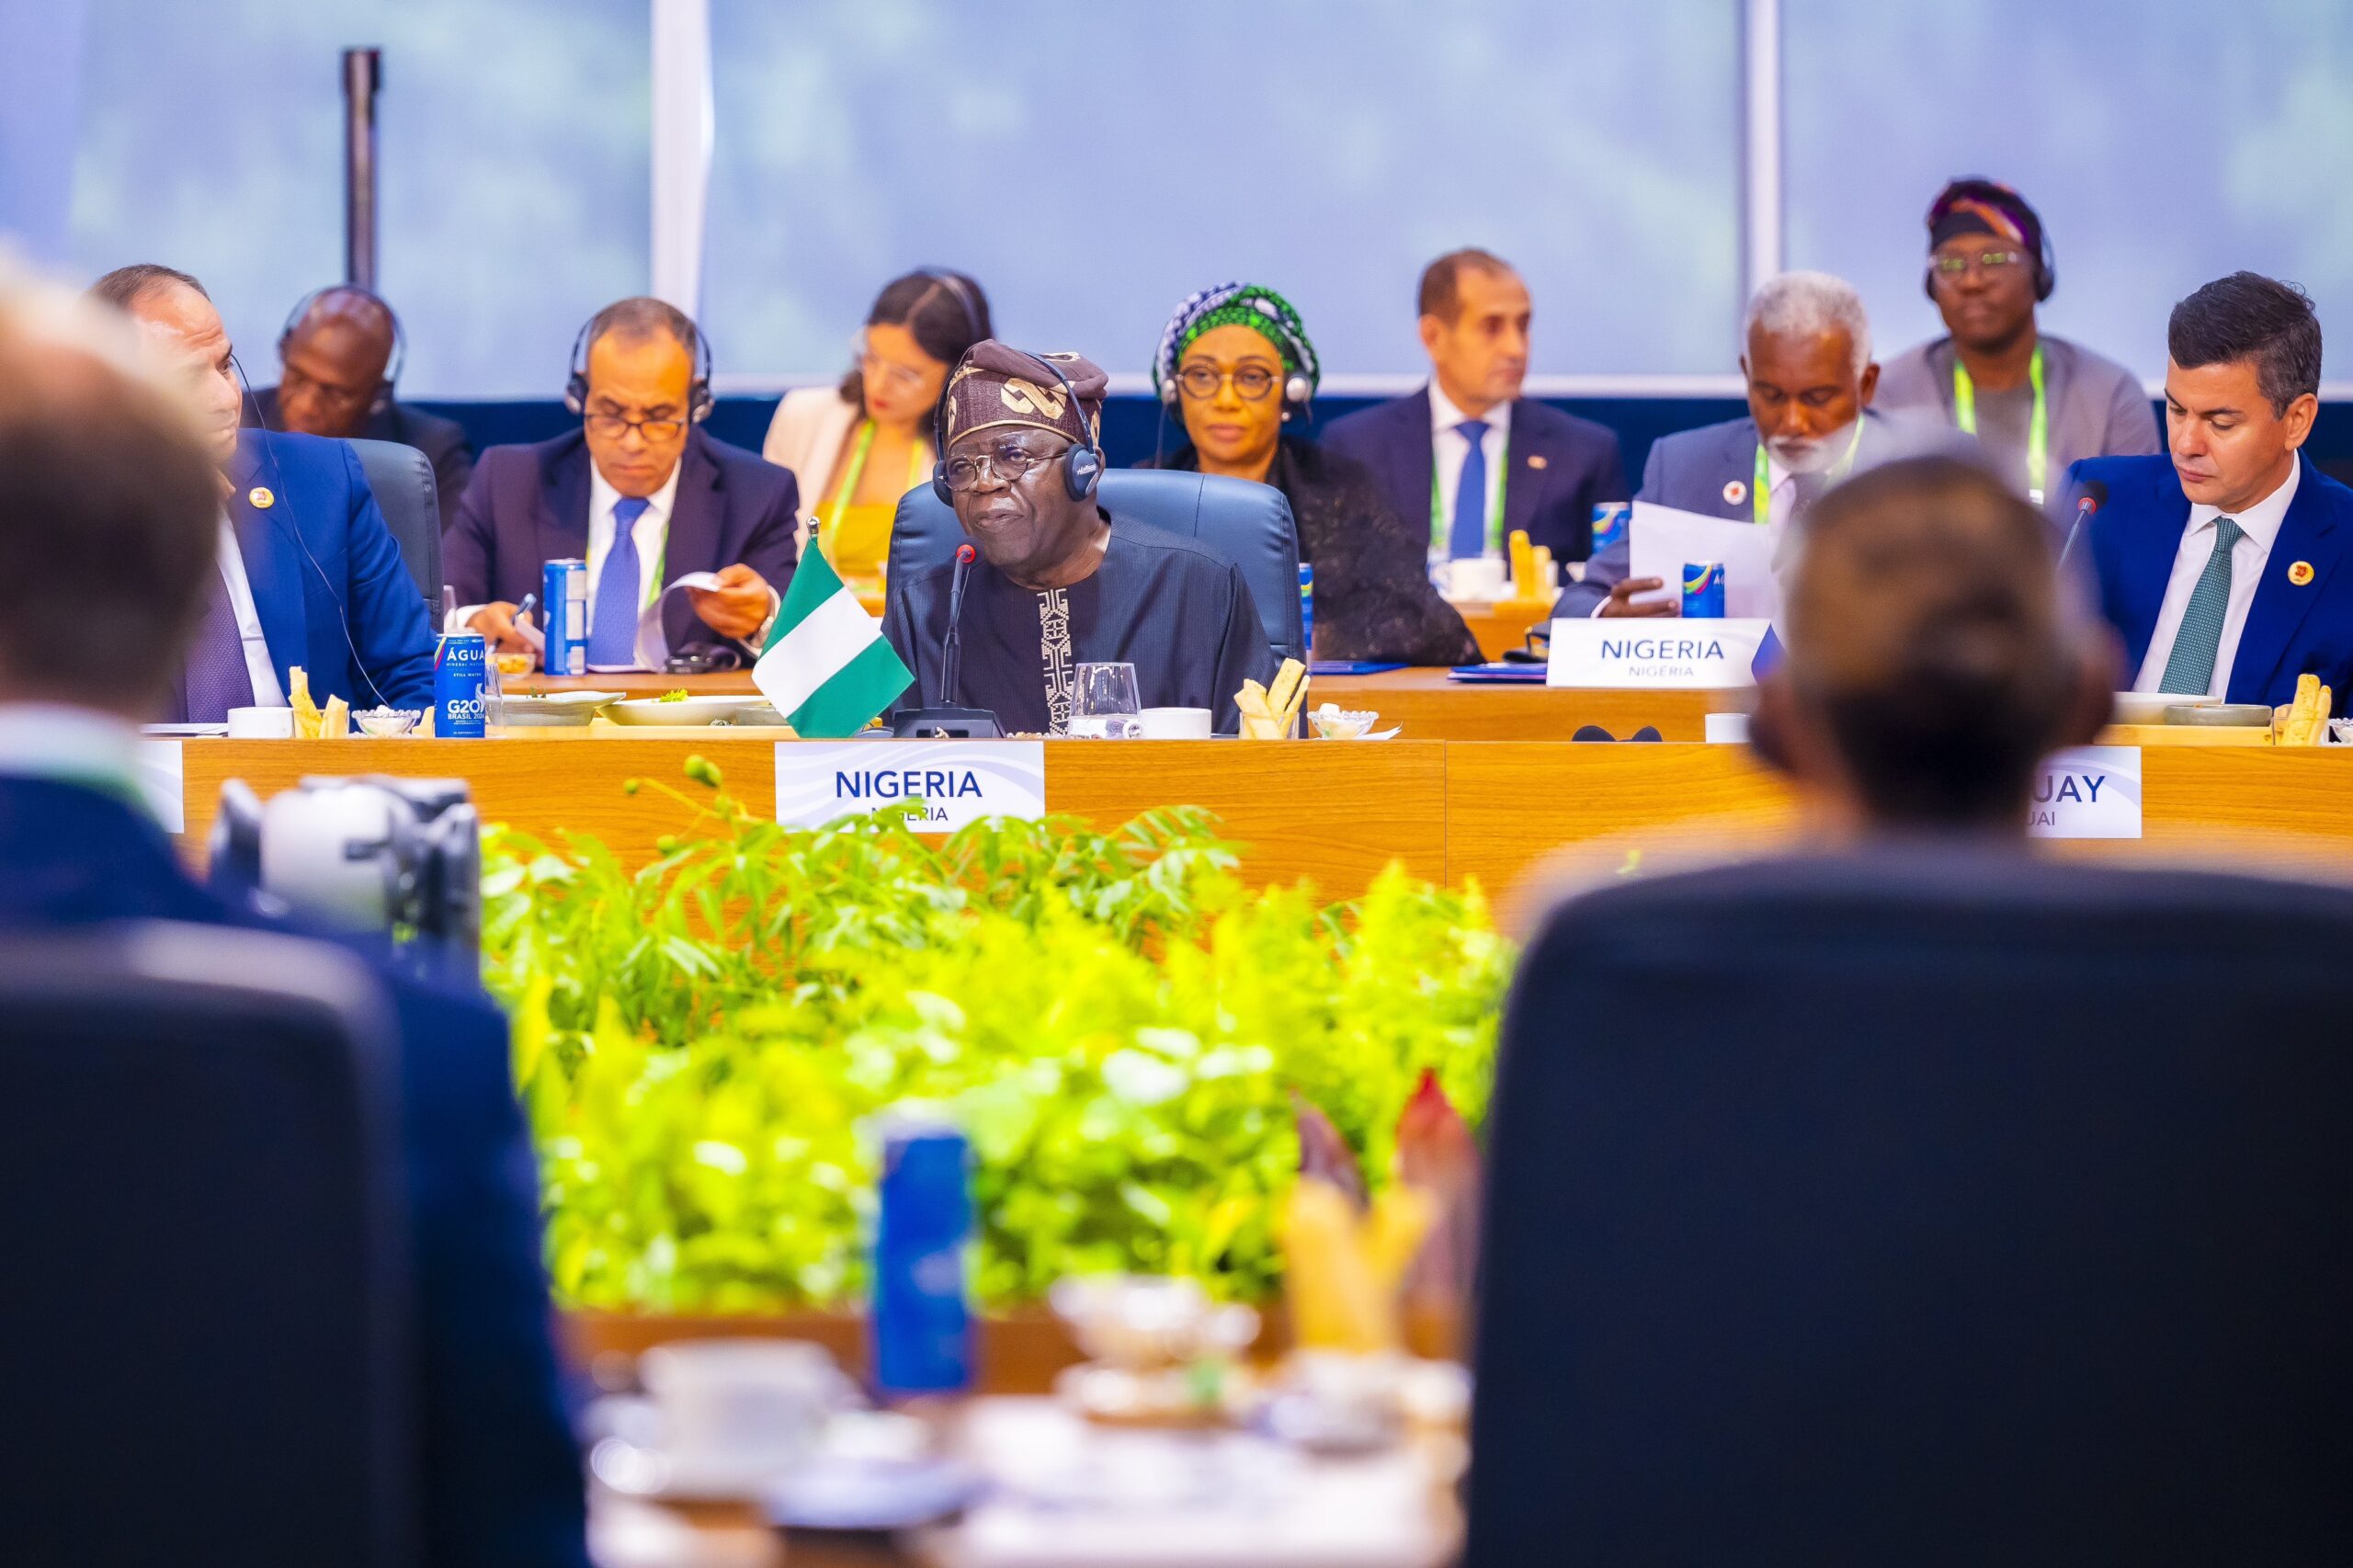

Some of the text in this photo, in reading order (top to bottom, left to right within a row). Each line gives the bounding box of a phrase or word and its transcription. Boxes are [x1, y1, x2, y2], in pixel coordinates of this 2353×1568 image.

[447, 647, 484, 661] ÁGUA
[1601, 640, 1724, 660] NIGERIA
[448, 699, 480, 714] G20
[836, 770, 983, 798] NIGERIA
